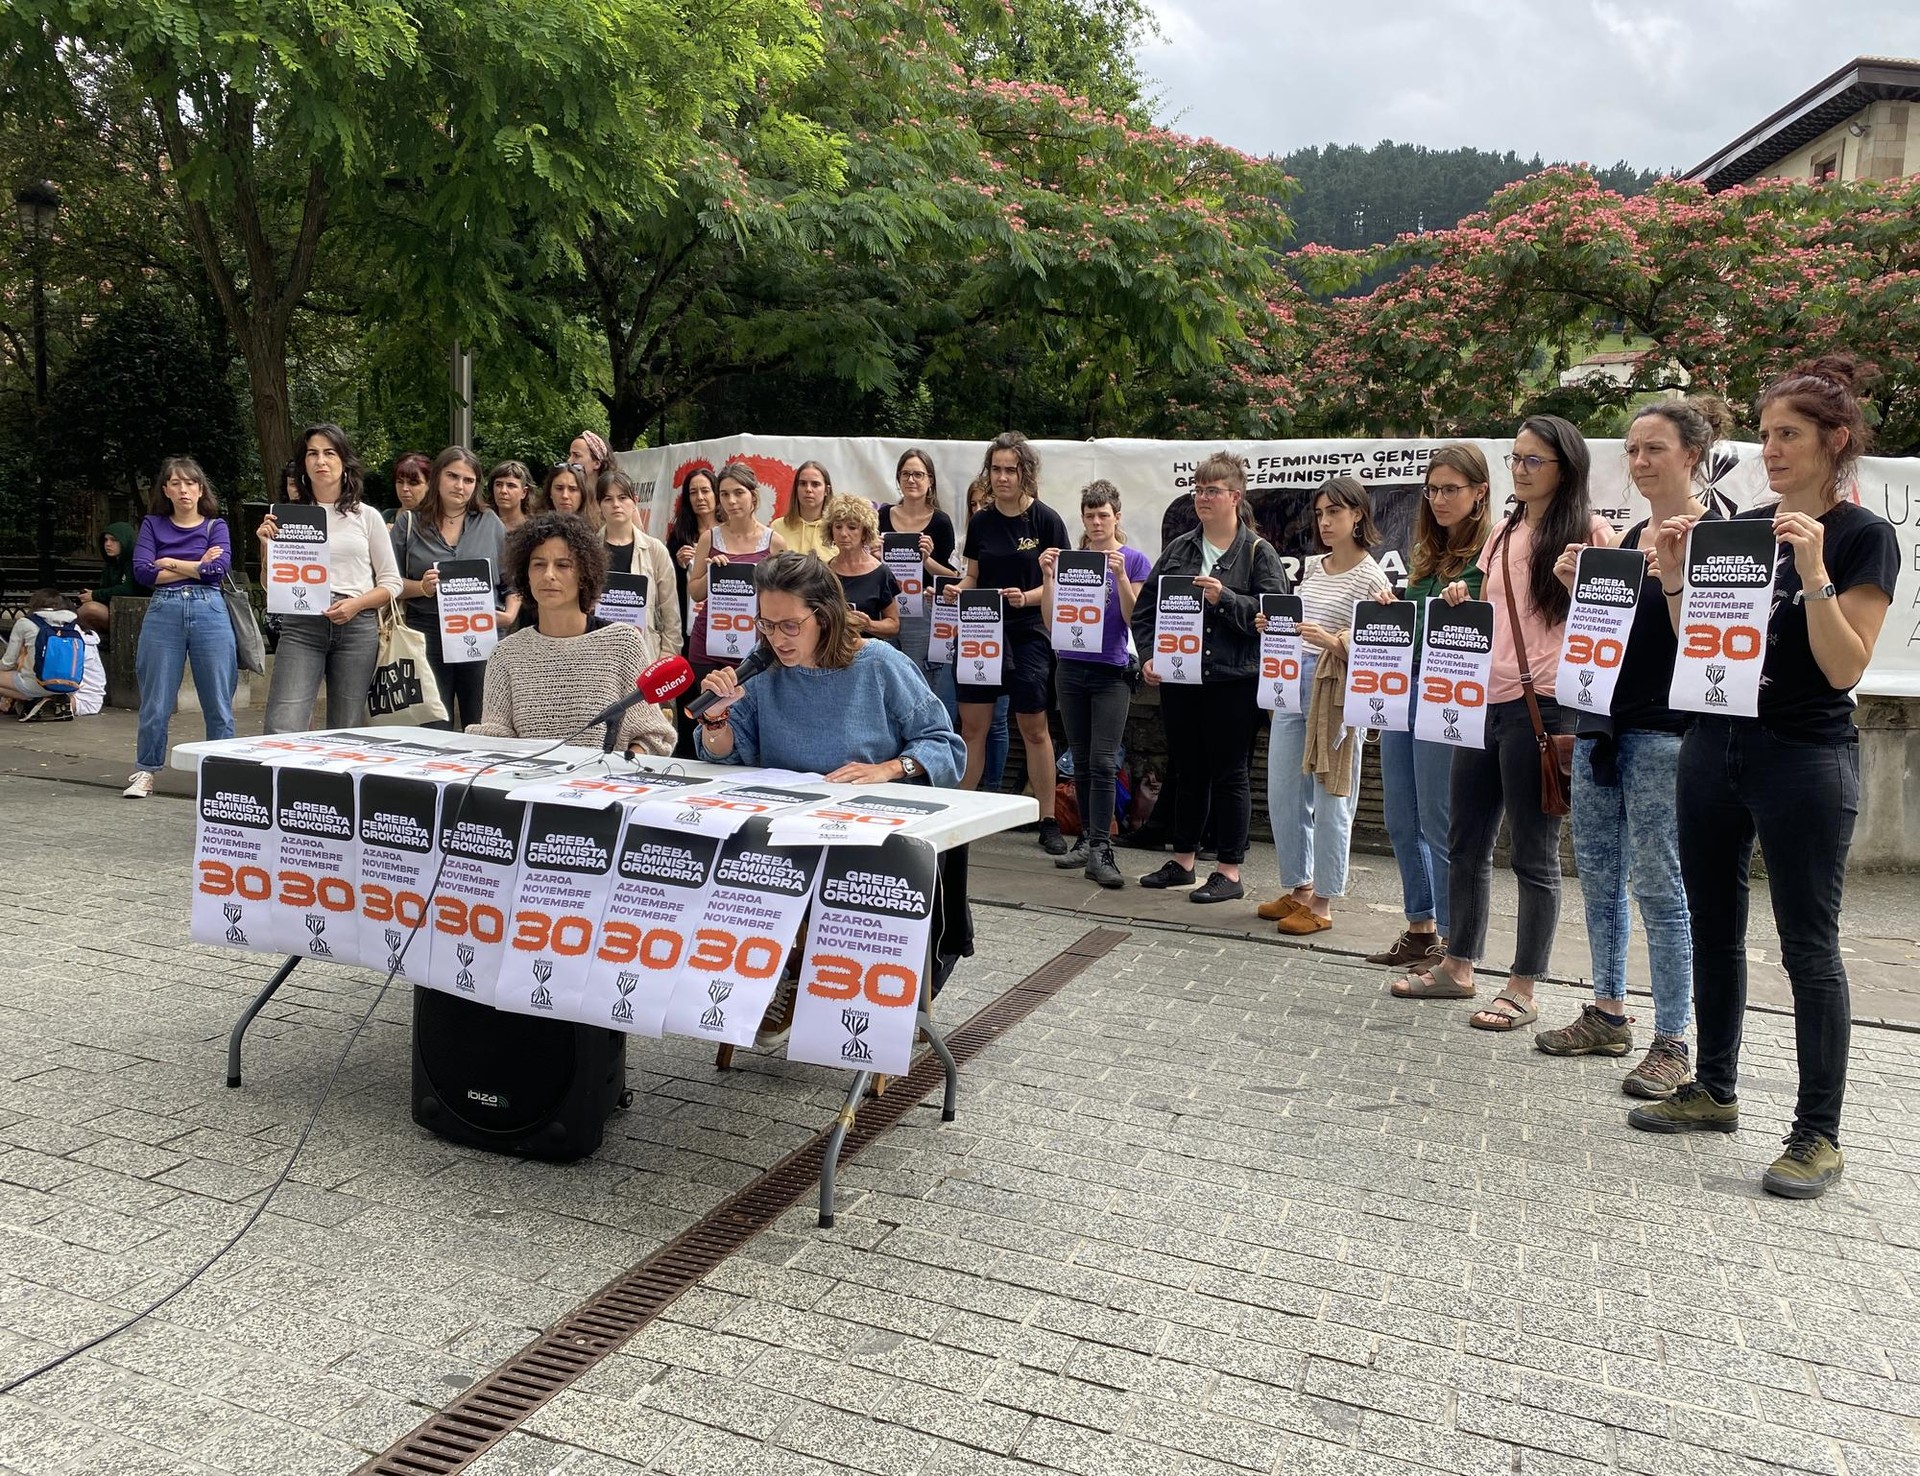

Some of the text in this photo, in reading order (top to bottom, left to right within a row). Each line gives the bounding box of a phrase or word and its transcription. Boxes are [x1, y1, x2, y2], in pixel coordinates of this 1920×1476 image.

[1258, 452, 1365, 469] FEMINISTA
[1373, 449, 1440, 463] GENER
[1360, 462, 1427, 479] GÉNÉR
[1707, 555, 1754, 564] GREBA
[272, 563, 327, 584] 30
[1691, 573, 1767, 582] OROKORRA
[1692, 565, 1767, 573] FEMINISTA
[1579, 584, 1634, 596] FEMINISTA
[1591, 577, 1625, 587] GREBA
[1577, 591, 1633, 604] OROKORRA
[1690, 591, 1735, 599] AZAROA
[1575, 606, 1609, 616] AZAROA
[1689, 601, 1754, 609] NOVIEMBRE
[1056, 604, 1101, 624] 30
[1573, 615, 1623, 626] NOVIEMBRE
[1688, 611, 1749, 620] NOVEMBRE
[444, 614, 494, 634] 30
[711, 614, 754, 632] 30
[1443, 625, 1479, 634] GREBA
[1571, 623, 1617, 634] NOVEMBRE
[1157, 634, 1200, 654] 30
[1356, 635, 1410, 643] OROKORRA
[1429, 637, 1489, 650] OROKORRA
[1431, 631, 1489, 643] FEMINISTA
[1683, 623, 1761, 661] 30
[961, 641, 1000, 658] 30
[1429, 651, 1464, 660] AZAROA
[1565, 634, 1623, 668] 30
[1263, 657, 1298, 680] 30
[1426, 666, 1475, 676] NOVEMBRE
[1427, 658, 1479, 669] NOVIEMBRE
[655, 675, 686, 697] goiena
[1351, 670, 1408, 695] 30
[1423, 676, 1484, 707] 30
[559, 780, 651, 794] 30
[215, 791, 257, 804] GREBA
[675, 796, 769, 812] 30
[203, 799, 269, 815] FEMINISTA
[293, 801, 337, 815] GREBA
[203, 808, 270, 825] OROKORRA
[280, 809, 350, 826] FEMINISTA
[374, 812, 417, 827] GREBA
[806, 810, 906, 825] 30
[204, 826, 244, 838] AZAROA
[280, 818, 350, 836] OROKORRA
[362, 819, 429, 838] FEMINISTA
[457, 822, 503, 838] GREBA
[202, 836, 261, 851] NOVIEMBRE
[281, 836, 324, 849] AZAROA
[361, 829, 429, 848] OROKORRA
[443, 829, 514, 849] FEMINISTA
[545, 833, 595, 847] GREBA
[201, 846, 258, 860] NOVEMBRE
[280, 846, 343, 861] NOVIEMBRE
[363, 848, 403, 862] AZAROA
[529, 842, 608, 859] FEMINISTA
[640, 844, 692, 860] GREBA
[280, 856, 340, 872] NOVEMBRE
[362, 857, 420, 875] NOVIEMBRE
[527, 852, 607, 869] OROKORRA
[624, 851, 704, 872] FEMINISTA
[739, 851, 793, 868] GREBA
[361, 868, 416, 886] NOVEMBRE
[621, 860, 702, 883] OROKORRA
[720, 859, 806, 881] FEMINISTA
[199, 859, 272, 901] 30
[440, 870, 500, 888] NOVIEMBRE
[525, 873, 572, 885] AZAROA
[717, 868, 803, 892] OROKORRA
[845, 870, 909, 889] GREBA
[277, 870, 355, 912] 30
[437, 880, 495, 898] NOVEMBRE
[522, 884, 592, 899] NOVIEMBRE
[616, 882, 665, 897] AZAROA
[711, 889, 762, 904] AZAROA
[826, 879, 926, 903] FEMINISTA
[360, 882, 427, 929] 30
[520, 895, 585, 910] NOVEMBRE
[613, 893, 685, 912] NOVIEMBRE
[707, 901, 782, 920] NOVIEMBRE
[823, 890, 926, 914] OROKORRA
[434, 895, 504, 944] 30
[610, 905, 677, 923] NOVEMBRE
[703, 912, 774, 931] NOVEMBRE
[821, 912, 883, 929] AZAROA
[512, 910, 593, 957] 30
[818, 924, 908, 945] NOVIEMBRE
[596, 919, 684, 970] 30
[816, 936, 902, 957] NOVEMBRE
[687, 927, 783, 980] 30
[806, 953, 918, 1008] 30
[845, 1007, 870, 1017] denon
[468, 1090, 498, 1102] ibiza
